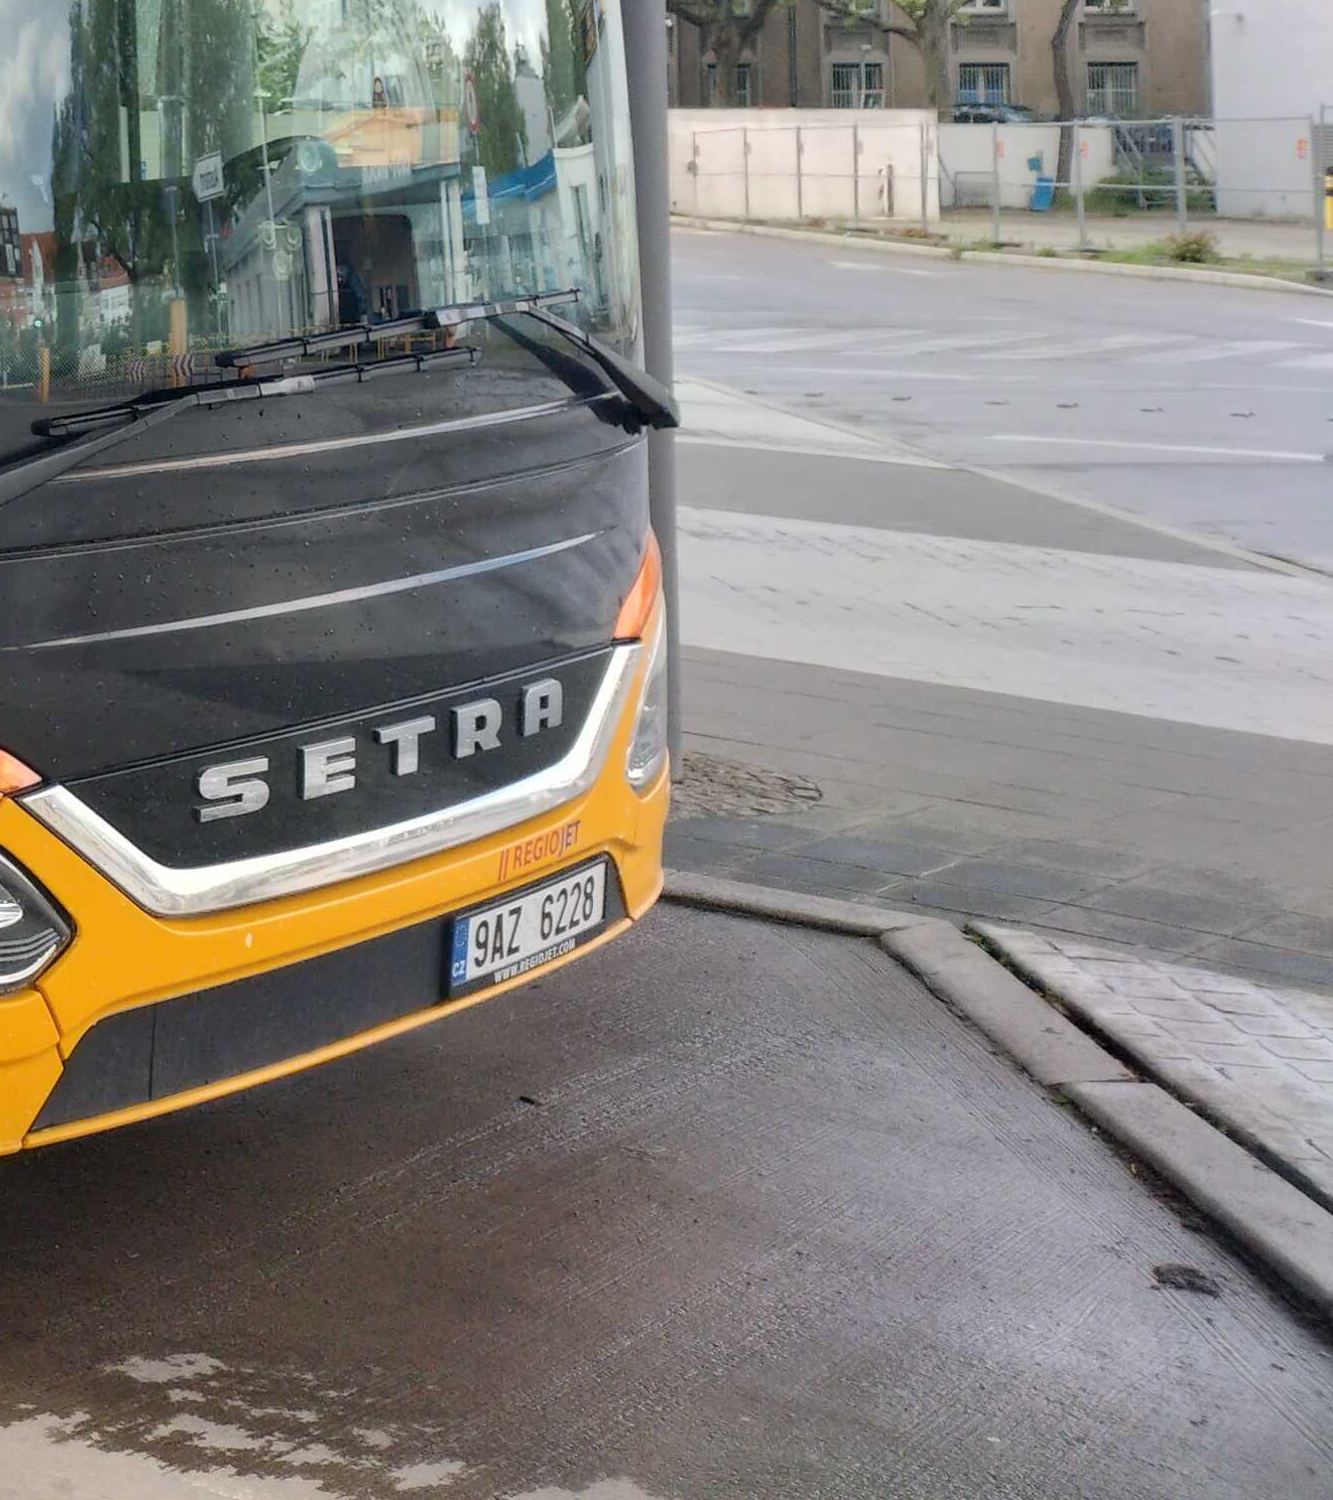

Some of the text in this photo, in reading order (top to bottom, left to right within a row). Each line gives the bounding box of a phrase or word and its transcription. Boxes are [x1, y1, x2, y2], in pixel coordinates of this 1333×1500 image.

[196, 678, 563, 822] SETRA
[513, 819, 582, 870] REGIOJET
[474, 875, 596, 967] 9AZ 6228
[452, 959, 466, 975] CZ
[493, 937, 576, 983] WWW.REGIOJET.COM
